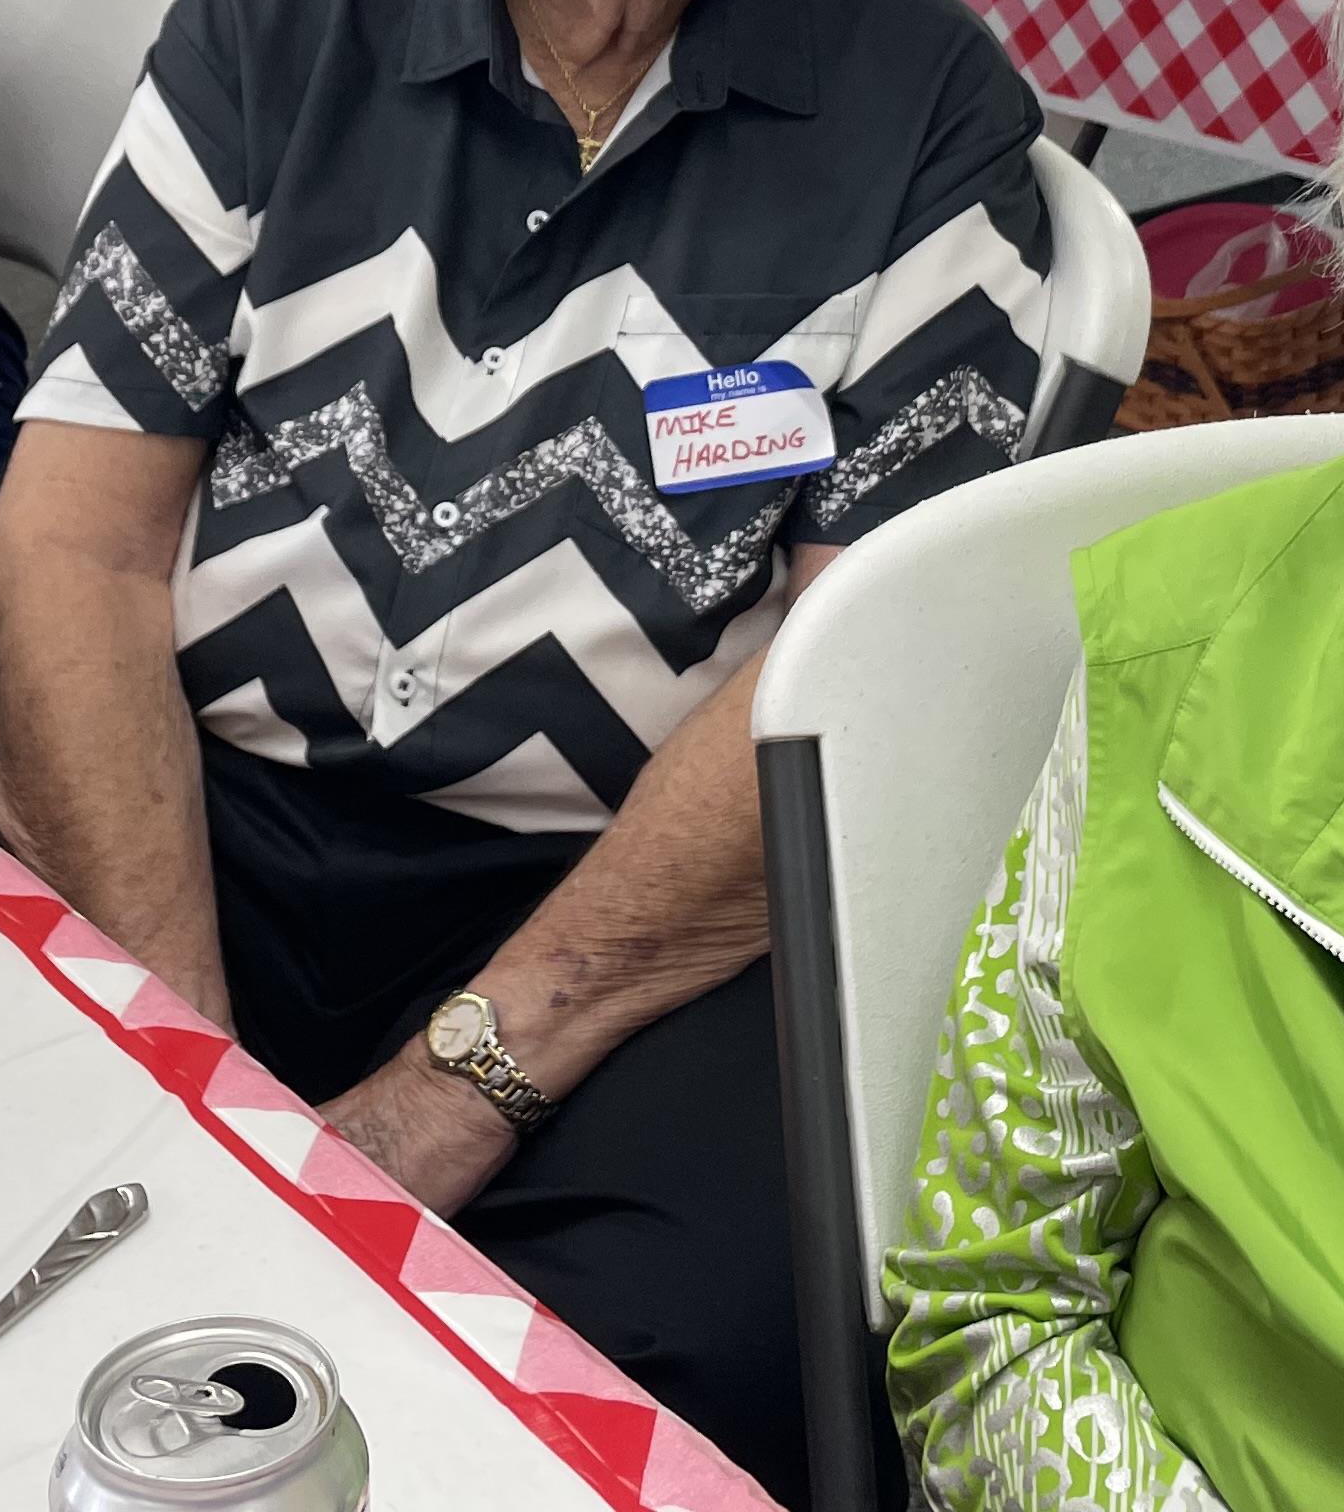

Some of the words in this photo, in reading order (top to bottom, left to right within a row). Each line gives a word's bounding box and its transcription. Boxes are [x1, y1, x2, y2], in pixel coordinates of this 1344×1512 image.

[707, 368, 759, 392] Hello
[656, 405, 736, 439] MIKE
[672, 427, 806, 478] HARDING
